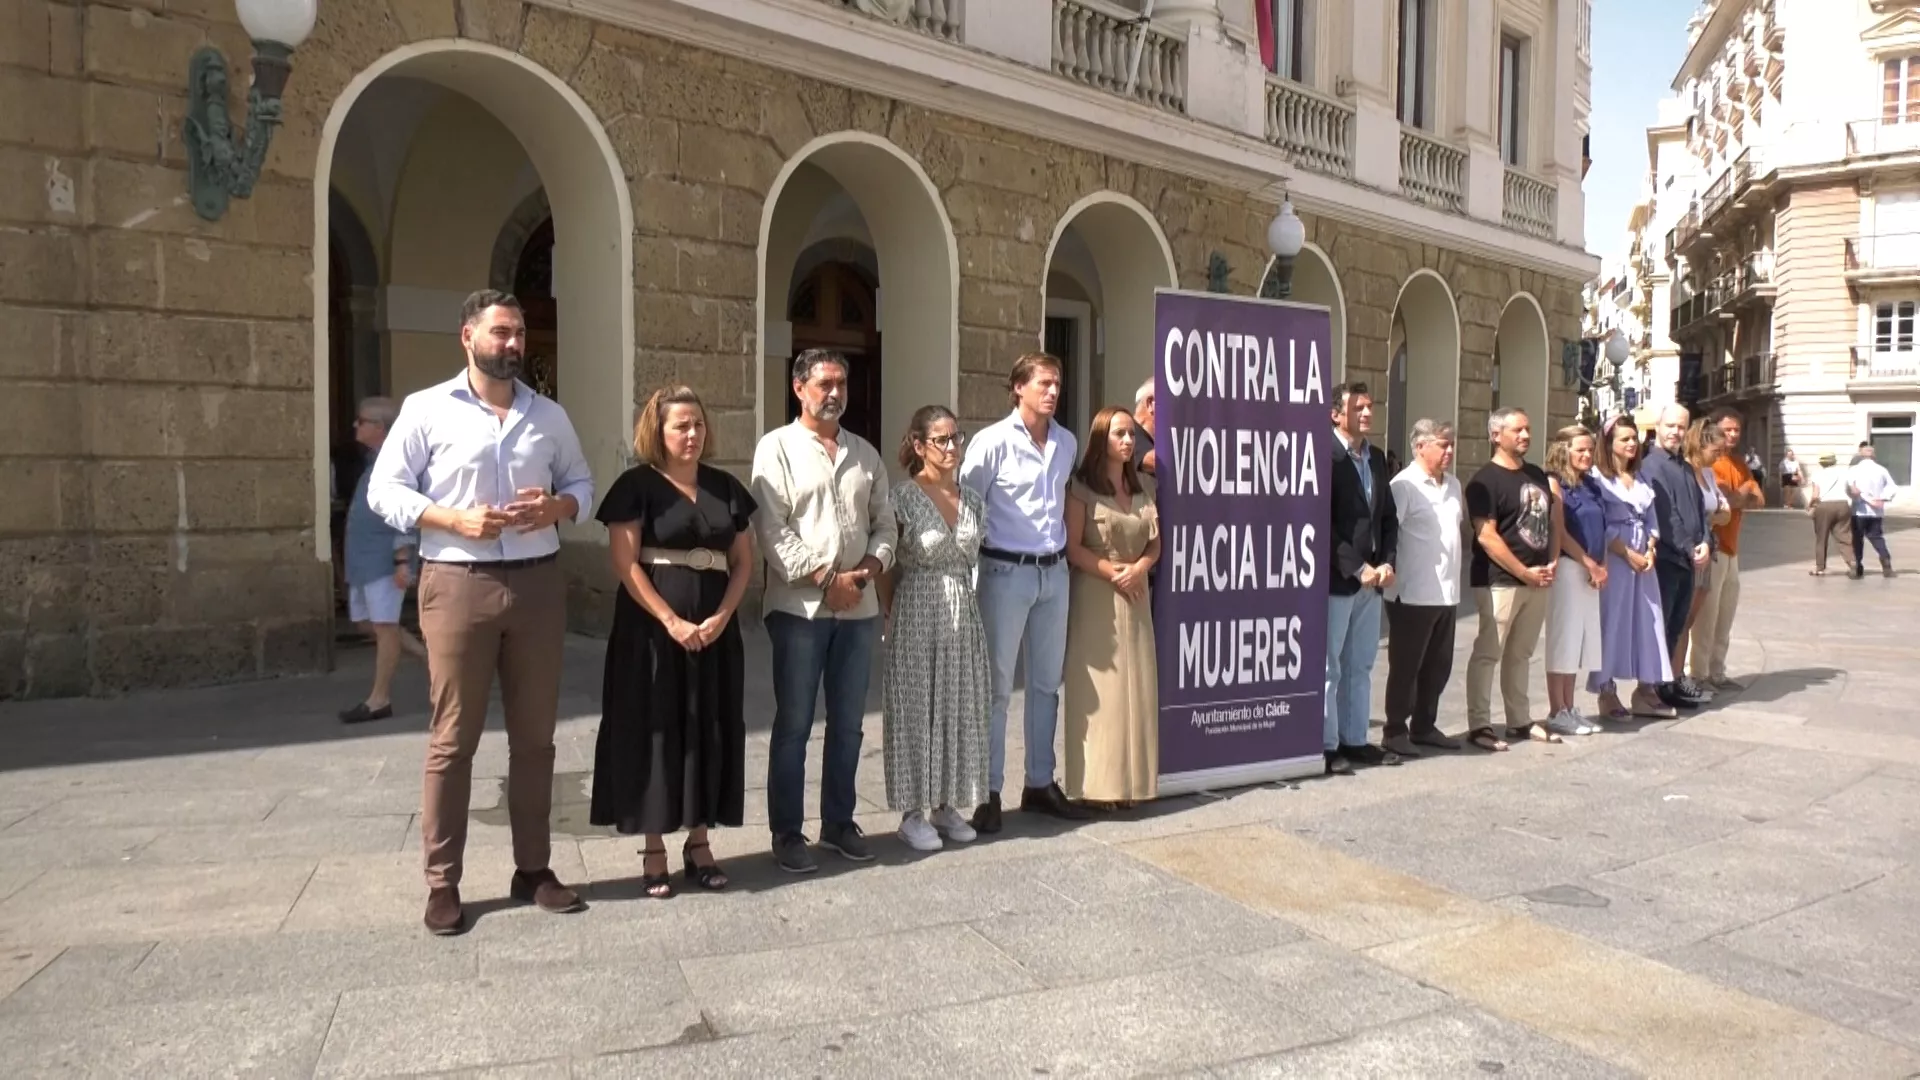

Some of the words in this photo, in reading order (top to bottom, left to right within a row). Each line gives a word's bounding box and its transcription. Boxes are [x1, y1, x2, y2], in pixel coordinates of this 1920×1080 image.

[1164, 326, 1280, 403] CONTRA
[1288, 338, 1325, 405] LA
[1170, 426, 1319, 497] VIOLENCIA
[1171, 523, 1258, 593] HACIA
[1266, 522, 1316, 589] LAS
[1178, 615, 1302, 689] MUJERES
[1190, 705, 1252, 727] Ayuntamiento
[1252, 704, 1264, 719] de
[1265, 701, 1290, 717] Cádiz
